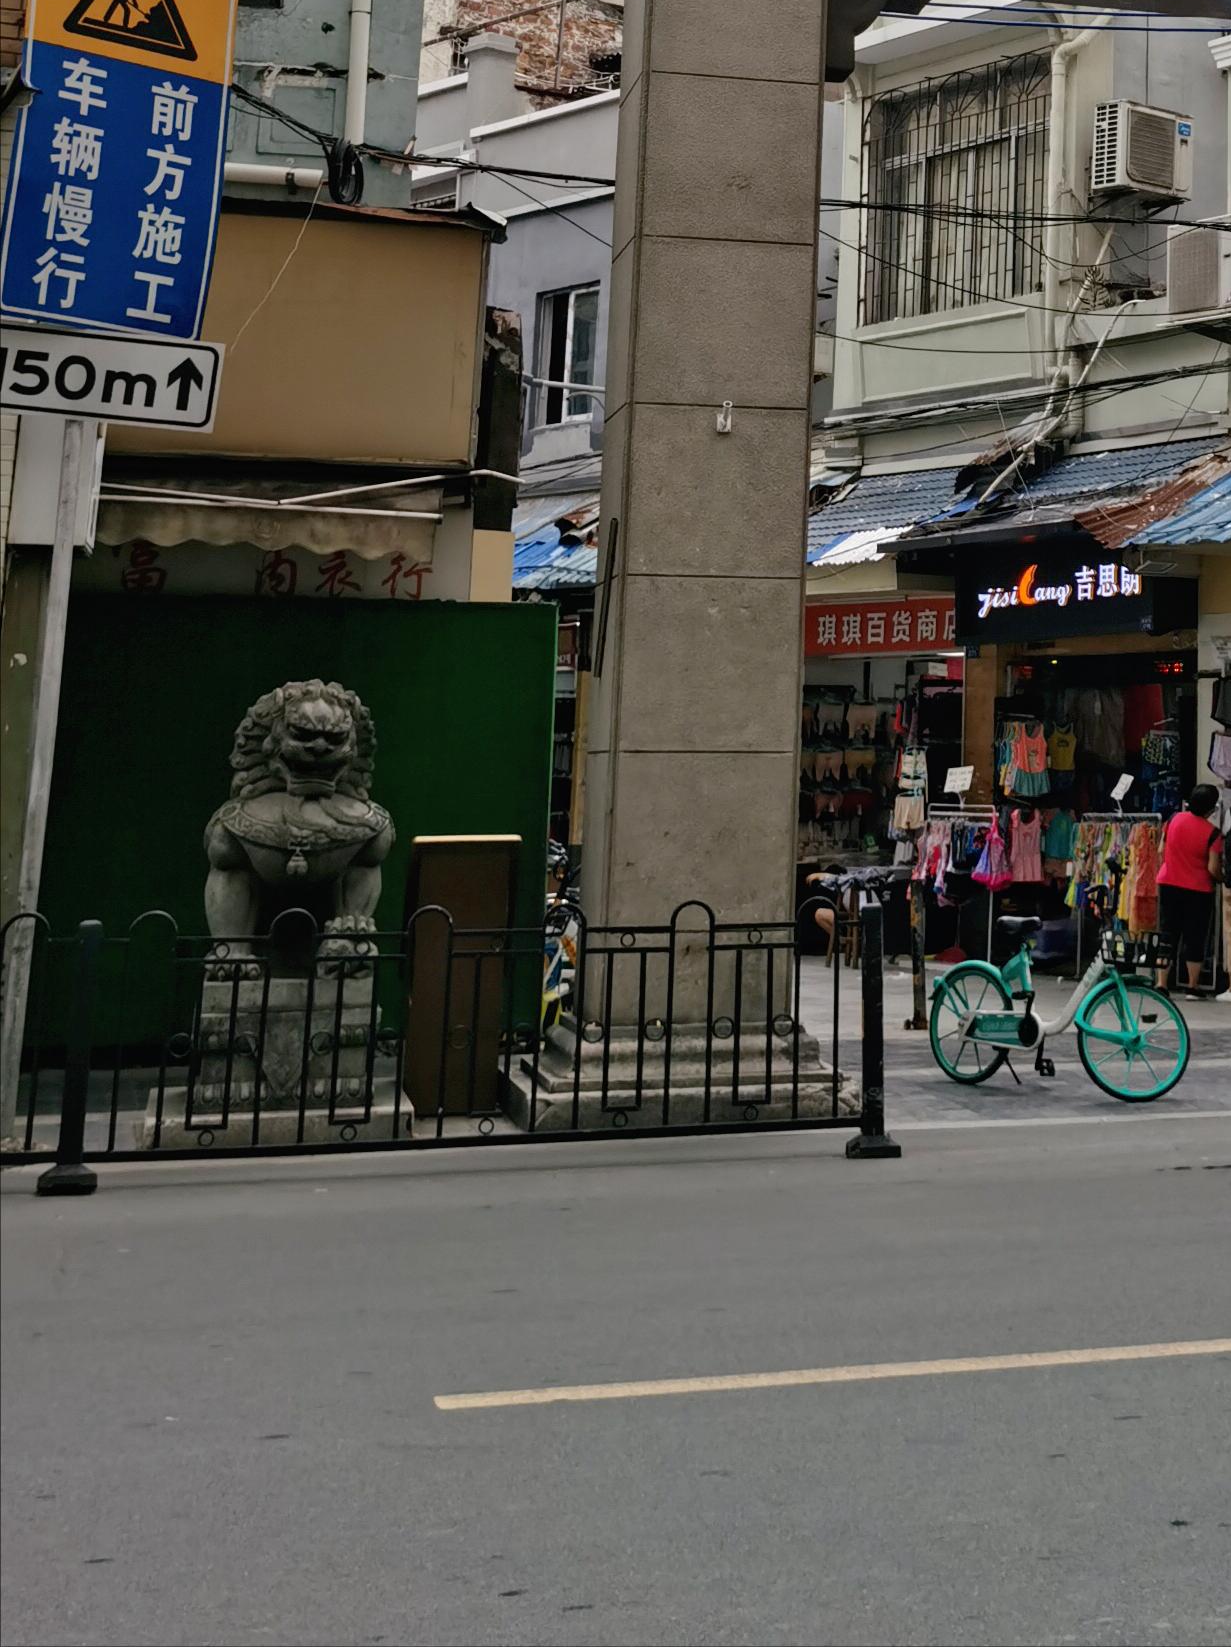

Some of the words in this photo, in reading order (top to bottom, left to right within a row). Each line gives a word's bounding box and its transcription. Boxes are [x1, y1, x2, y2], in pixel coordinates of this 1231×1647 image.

[32, 57, 108, 310] 车辆慢行
[126, 80, 199, 325] 前方施工
[817, 608, 956, 647] 琪琪百货商店
[1074, 563, 1142, 601] 吉思朗
